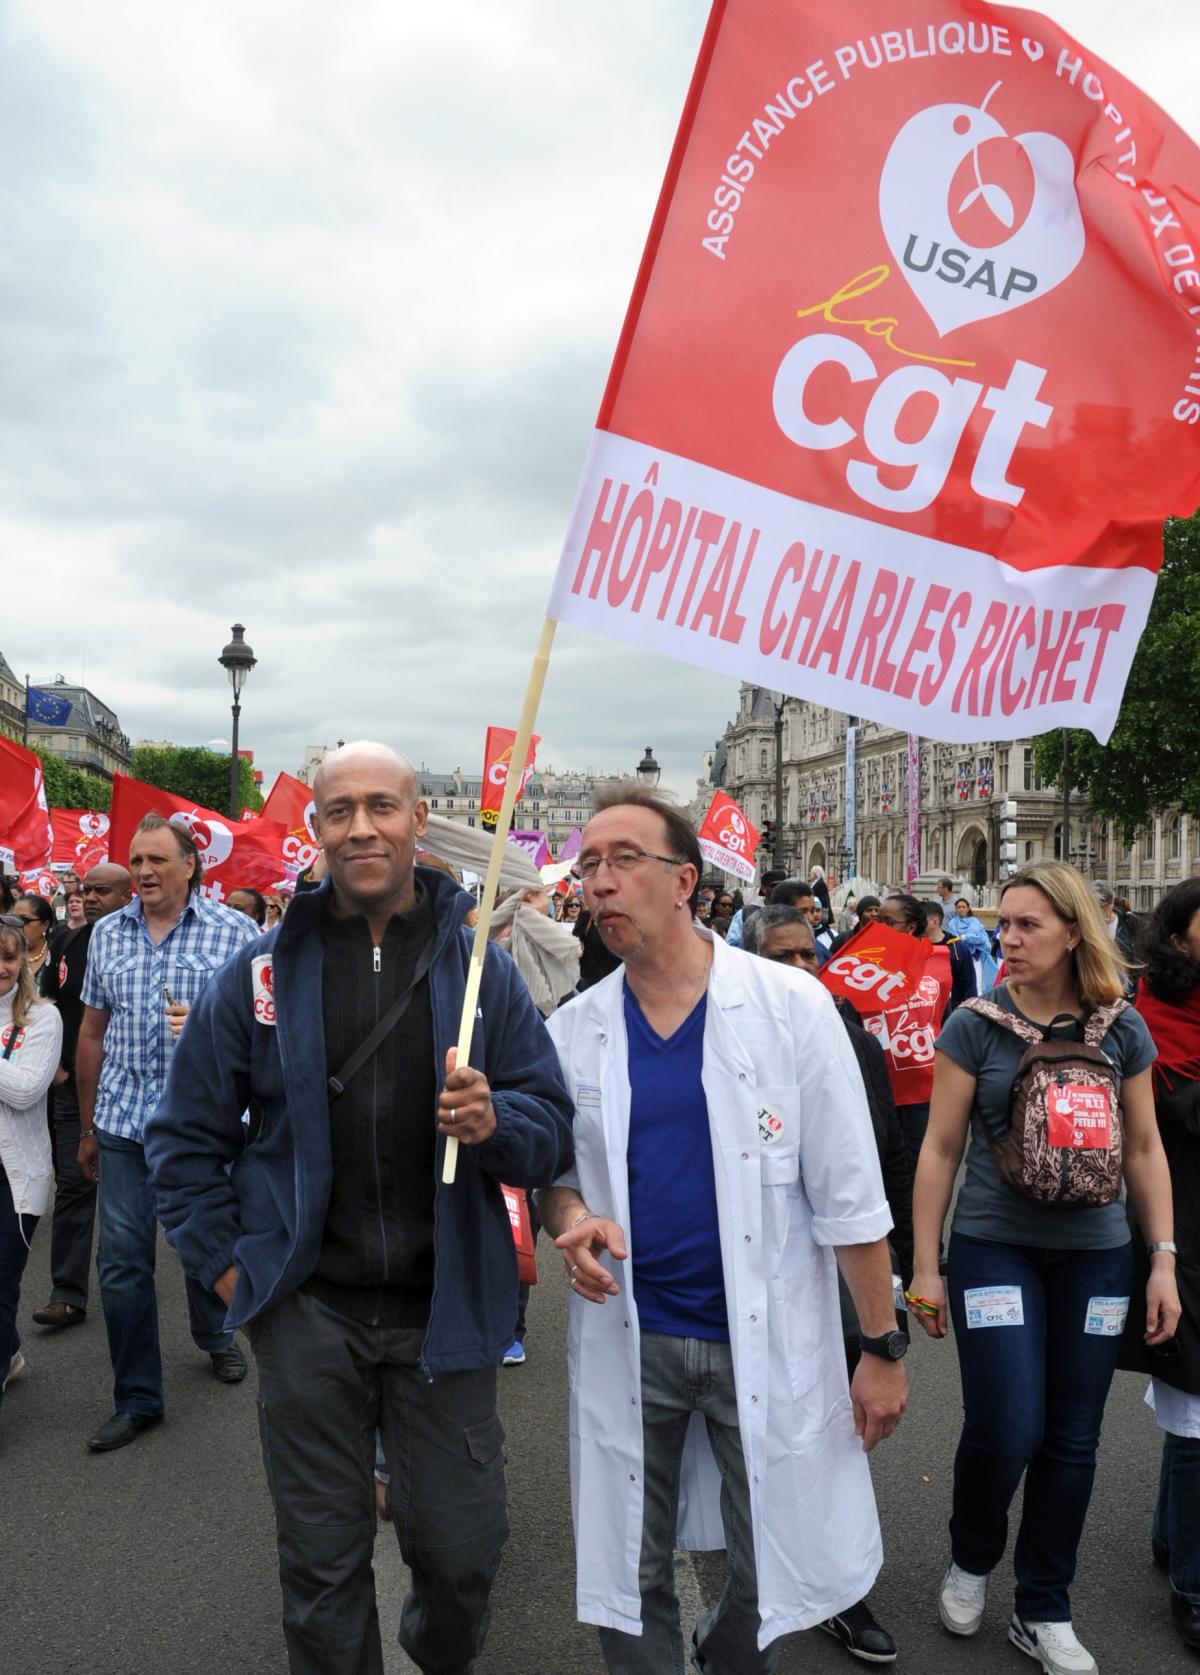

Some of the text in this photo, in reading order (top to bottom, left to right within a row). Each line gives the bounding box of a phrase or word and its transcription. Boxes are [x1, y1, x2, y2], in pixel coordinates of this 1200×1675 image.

[702, 60, 836, 260] ASSISTANCE
[839, 21, 1013, 79] PUBLIQUE
[902, 234, 1039, 302] USAP
[797, 264, 976, 367] la
[772, 333, 1053, 514] cgt
[572, 462, 1126, 718] HÔPITAL CHARLES RICHET
[719, 829, 746, 853] cgt
[827, 956, 906, 1002] cgt
[891, 1011, 929, 1037] la
[986, 1314, 1004, 1322] CFTC
